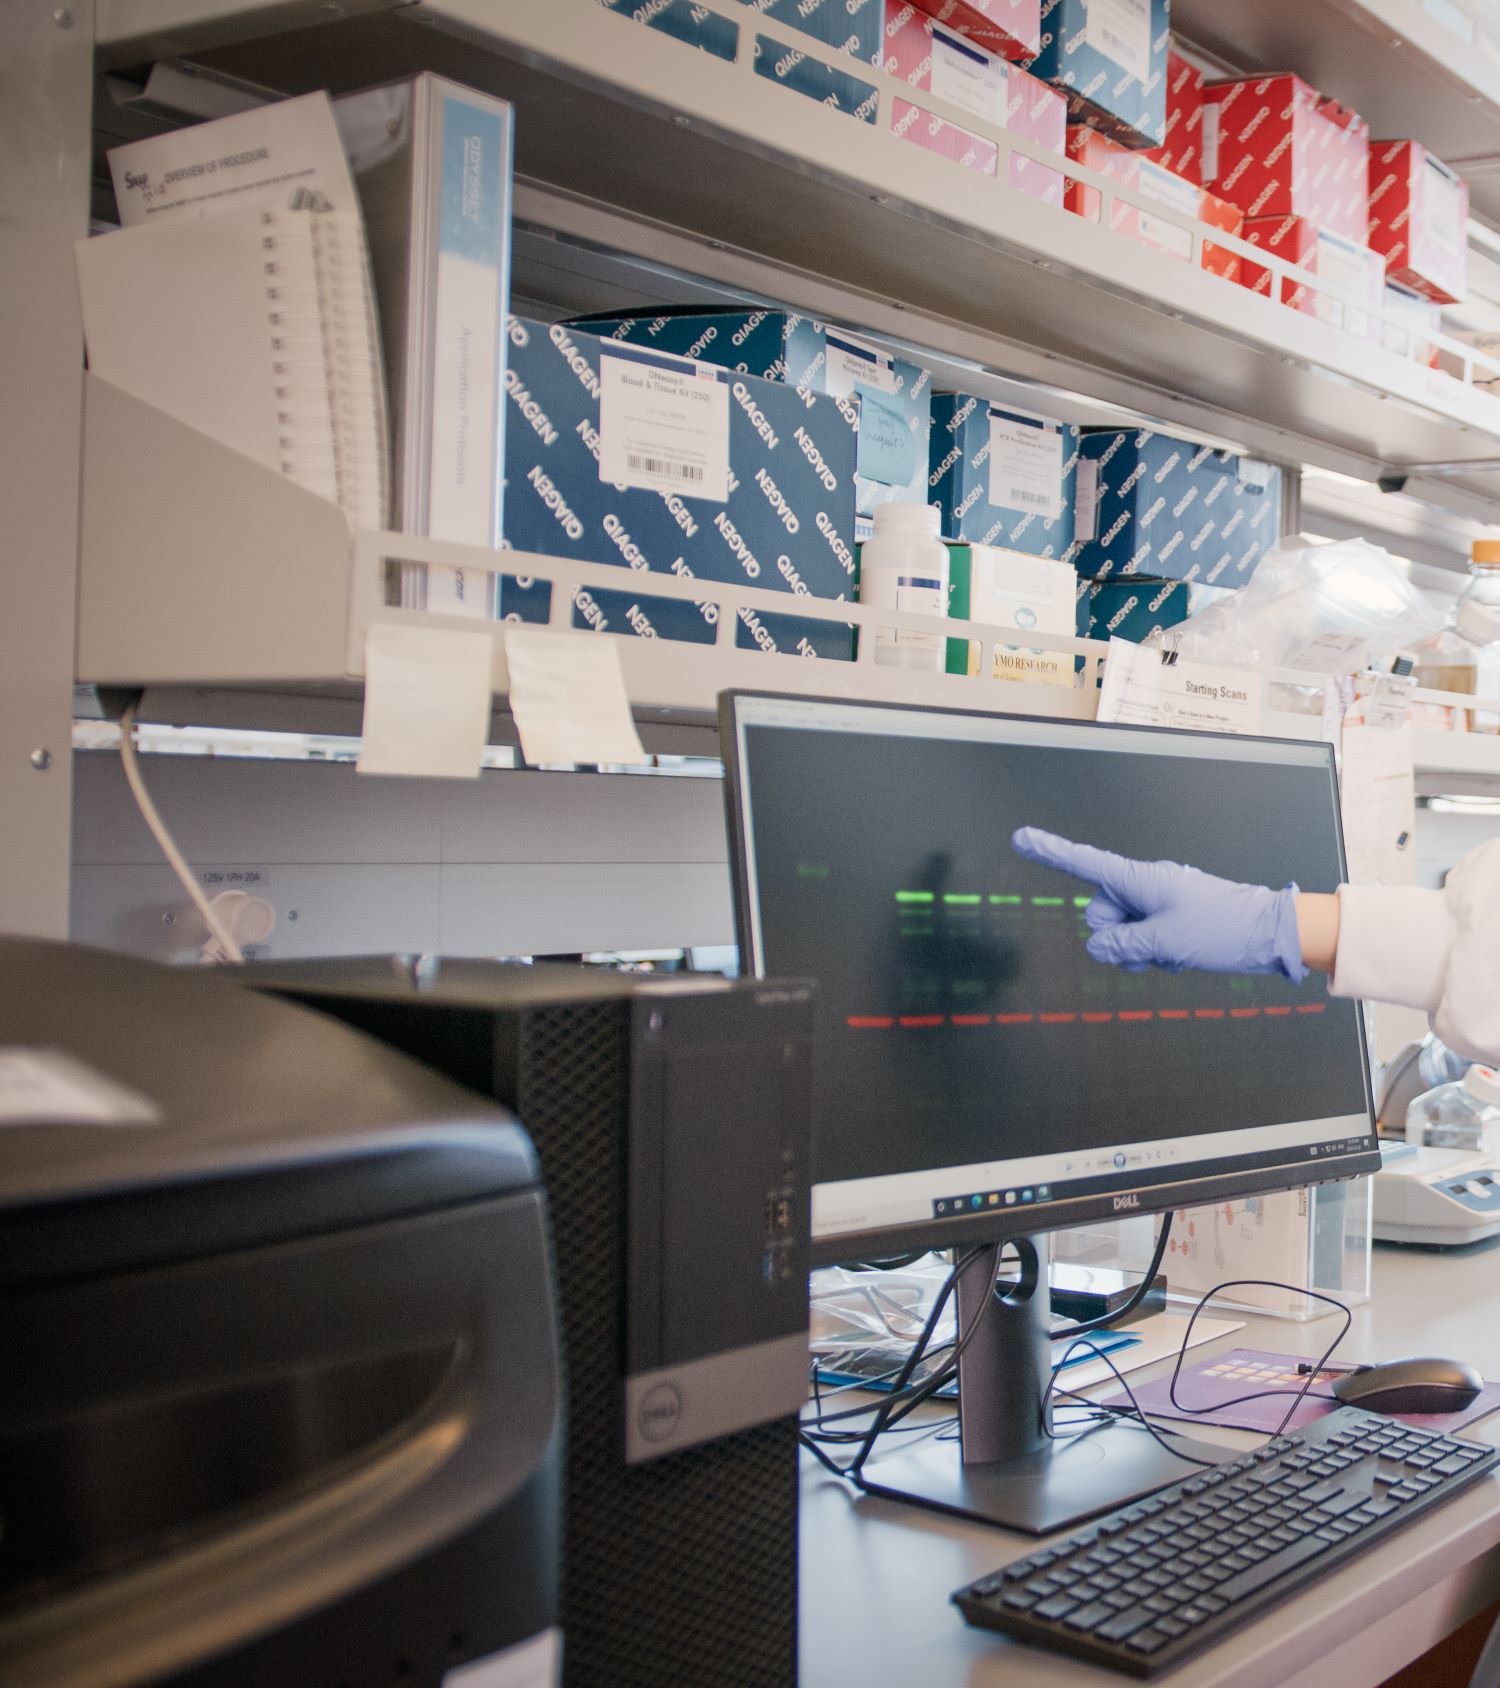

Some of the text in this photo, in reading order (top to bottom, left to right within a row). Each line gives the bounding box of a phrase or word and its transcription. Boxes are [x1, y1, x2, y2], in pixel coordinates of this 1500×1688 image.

[886, 4, 916, 37] QIAGEN
[163, 163, 205, 184] OVERVIEW
[205, 160, 217, 173] OF
[218, 147, 269, 169] PROCEDURE
[470, 135, 481, 224] ODYSSEY
[1222, 154, 1254, 191] QIAGEN
[1248, 180, 1280, 216] QIAGEN
[456, 325, 472, 411] Application
[503, 370, 559, 445] QIAGEN
[621, 374, 711, 404] Blood & Tissue Kit (250)
[733, 382, 779, 449] QIAGEN
[946, 397, 977, 433] QIAGEN
[794, 426, 838, 491] QIAGEN
[929, 446, 963, 486] QIAGEN
[1117, 462, 1147, 498] QIAGEN
[527, 465, 584, 540] QIAGEN
[755, 467, 799, 534] QIAGEN
[954, 483, 984, 518] QIAGEN
[714, 512, 761, 578] QIAGEN
[816, 511, 856, 575] QIAGEN
[1101, 510, 1131, 547] QIAGEN
[1107, 596, 1138, 631] QIAGEN
[993, 653, 1058, 673] YMO RESEARCH
[1185, 680, 1248, 700] Starting Scans
[226, 872, 243, 882] 1PH
[244, 872, 260, 882] 20A
[1113, 1194, 1140, 1210] DELL
